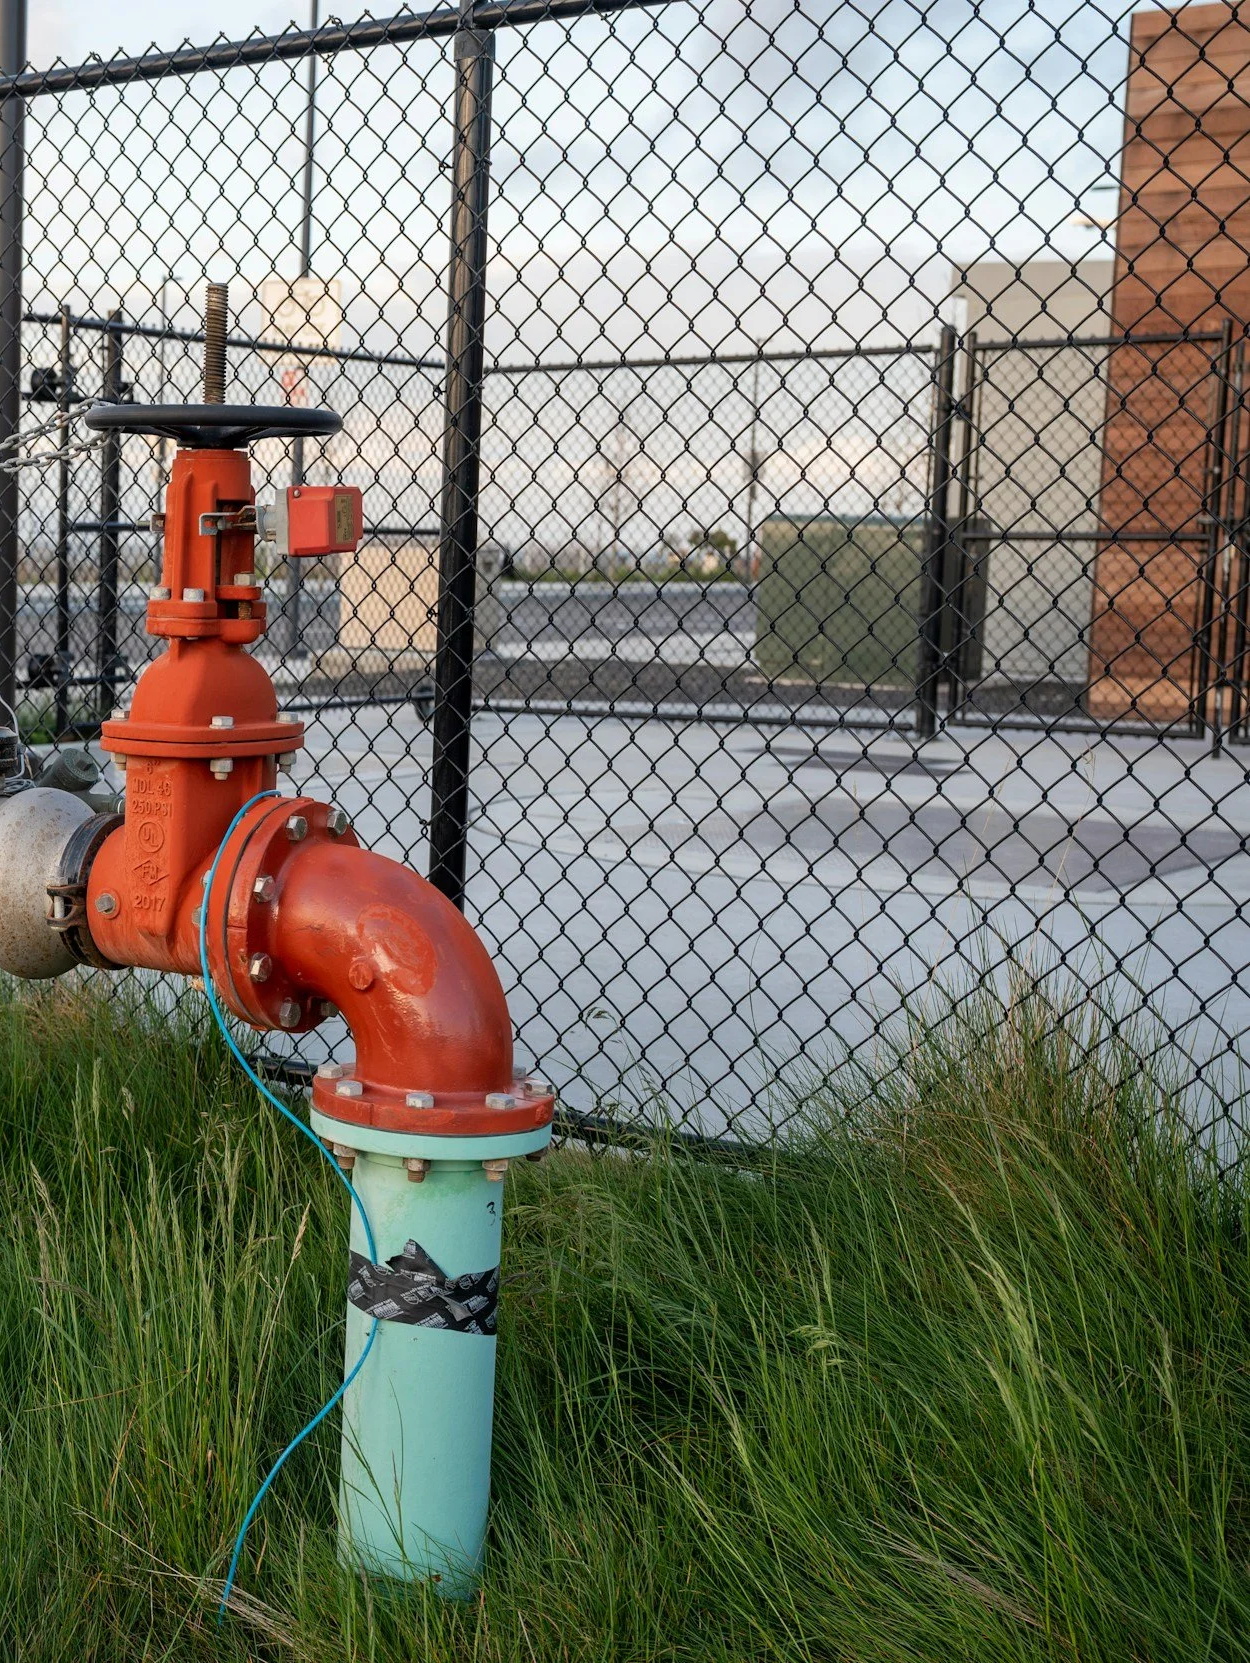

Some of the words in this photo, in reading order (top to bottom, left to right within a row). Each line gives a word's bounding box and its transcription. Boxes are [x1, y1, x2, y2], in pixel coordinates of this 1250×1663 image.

[132, 799, 152, 815] 250
[154, 801, 173, 818] PSI
[142, 826, 160, 848] UL
[133, 894, 166, 912] 2017
